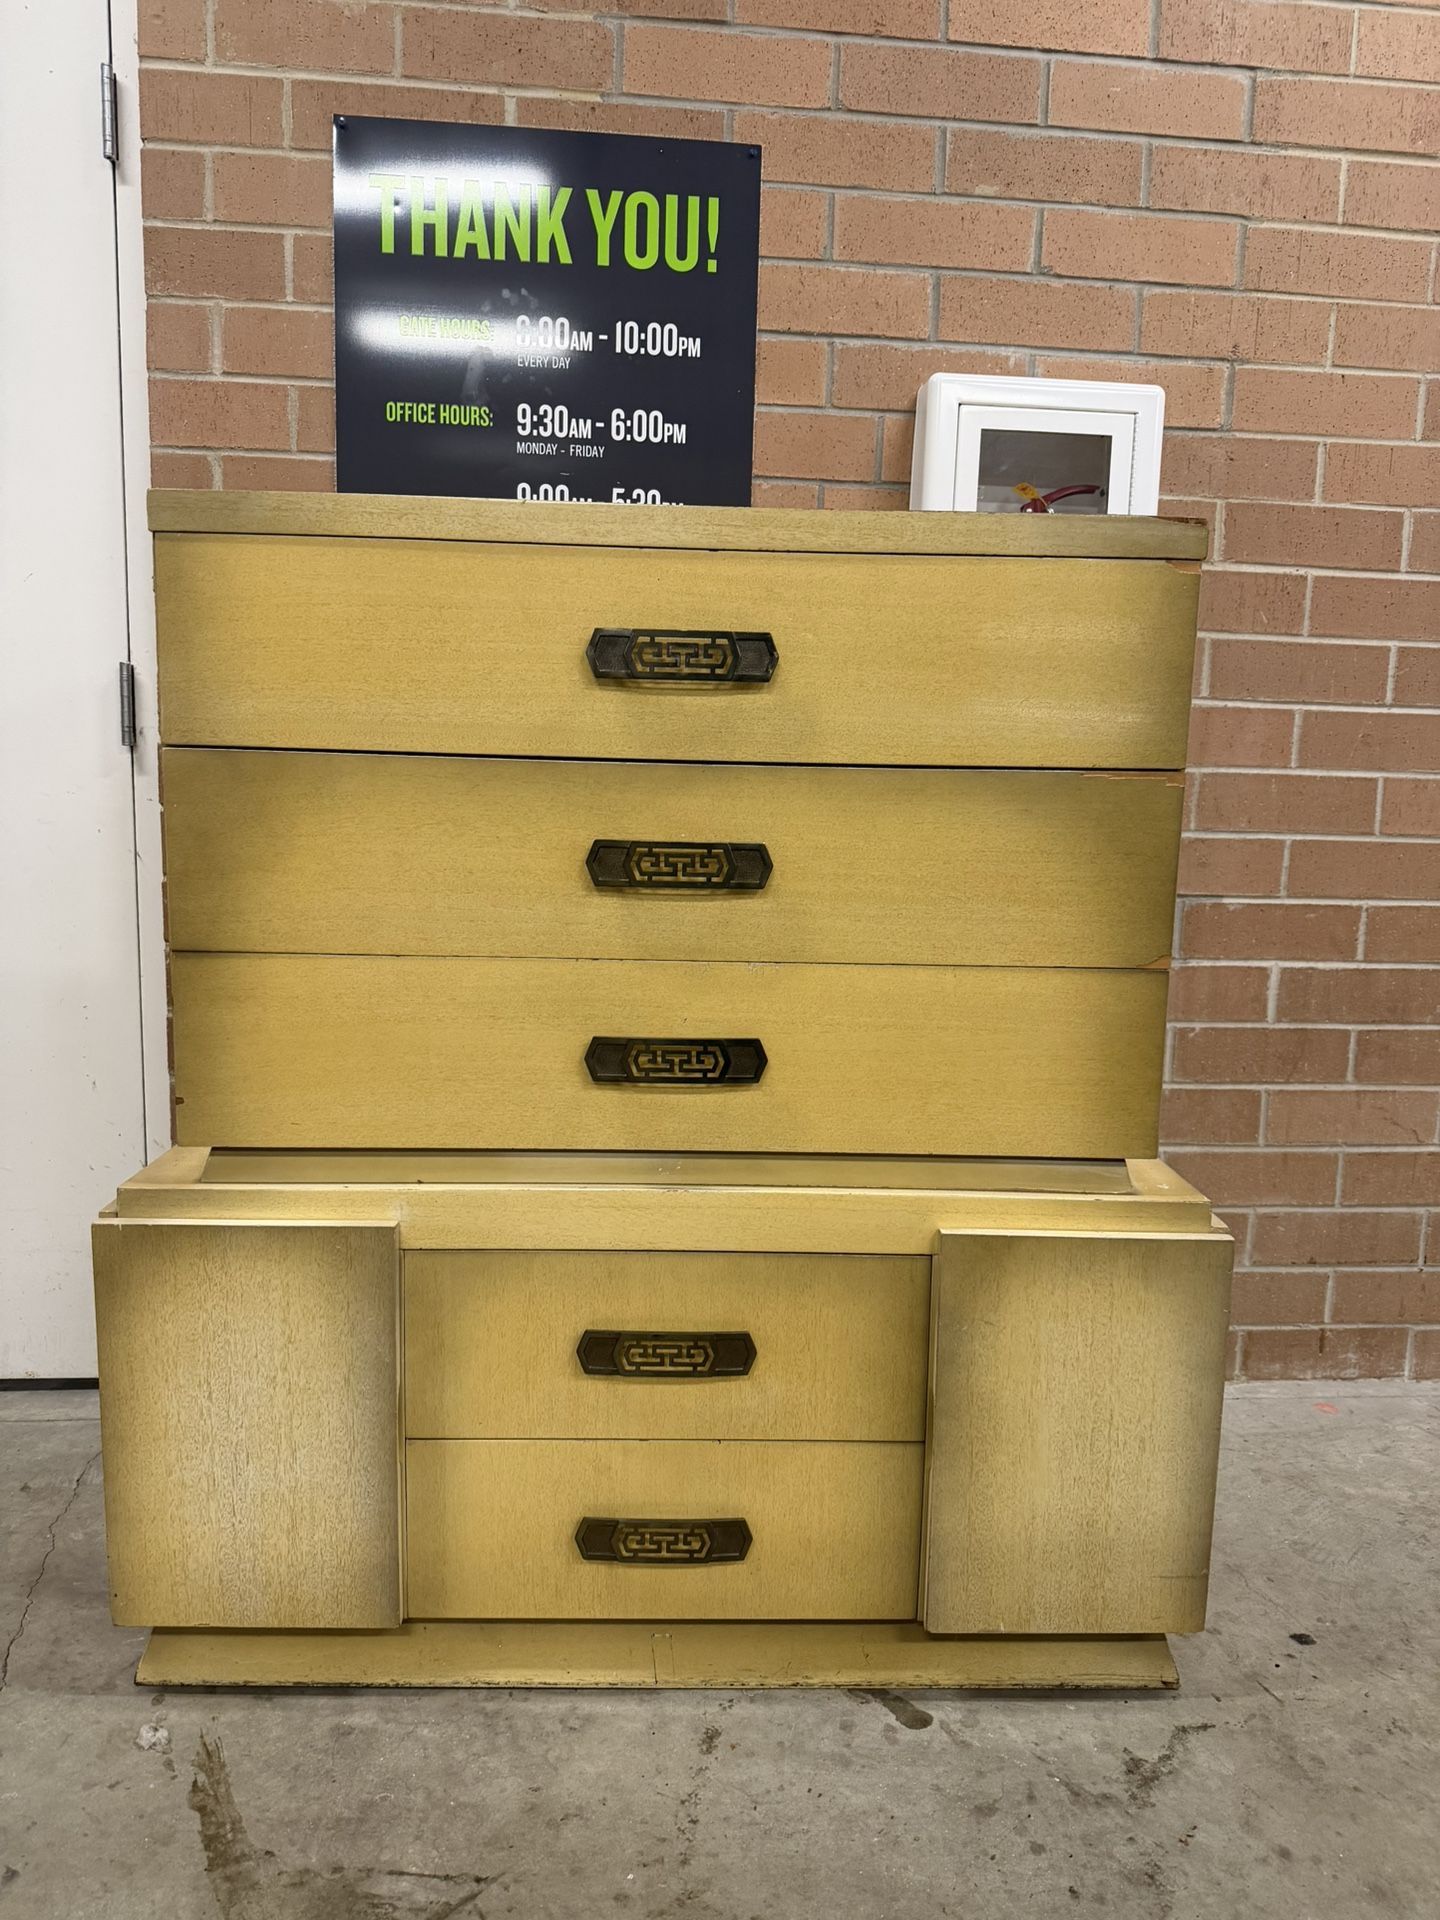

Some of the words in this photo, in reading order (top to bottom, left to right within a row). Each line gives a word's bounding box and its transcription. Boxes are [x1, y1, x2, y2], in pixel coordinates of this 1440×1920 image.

[369, 173, 573, 265] THANK
[586, 189, 719, 273] YOU!
[439, 316, 494, 342] HOURS:
[616, 320, 701, 358] 10:00PM
[517, 355, 549, 368] EVERY
[551, 356, 571, 370] DAY
[385, 401, 435, 424] OFFICE
[438, 404, 493, 428] HOURS:
[517, 402, 592, 439] 9:30AM
[611, 408, 687, 444] 6:00PM
[517, 442, 558, 456] MONDAY
[570, 445, 605, 458] FRIDAY
